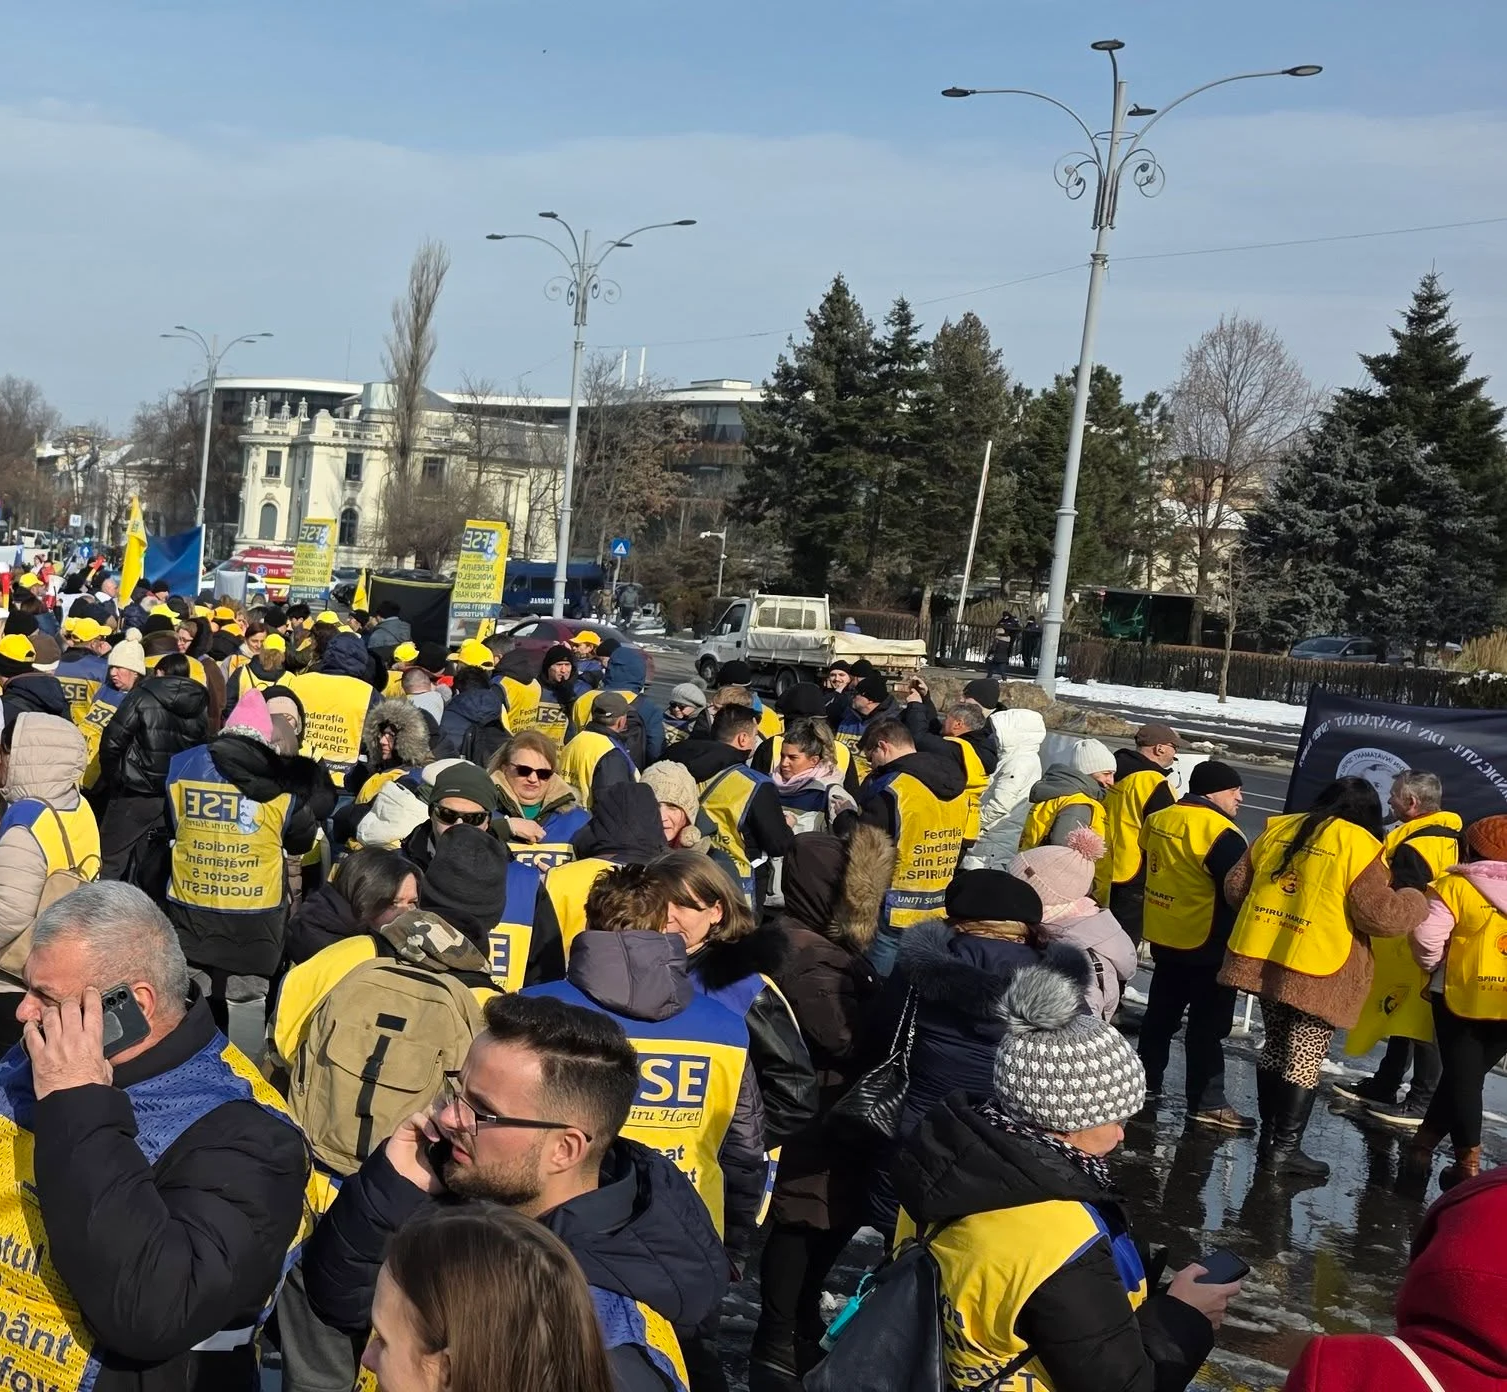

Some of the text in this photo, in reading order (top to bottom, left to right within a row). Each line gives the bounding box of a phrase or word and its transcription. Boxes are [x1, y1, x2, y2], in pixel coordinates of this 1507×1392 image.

[61, 683, 87, 700] SE
[305, 712, 344, 723] ederația
[305, 722, 348, 734] dicatelor
[912, 858, 933, 867] din
[1254, 905, 1312, 927] SPIRU HARET
[639, 1058, 707, 1103] SE
[630, 1107, 701, 1123] iru Haret
